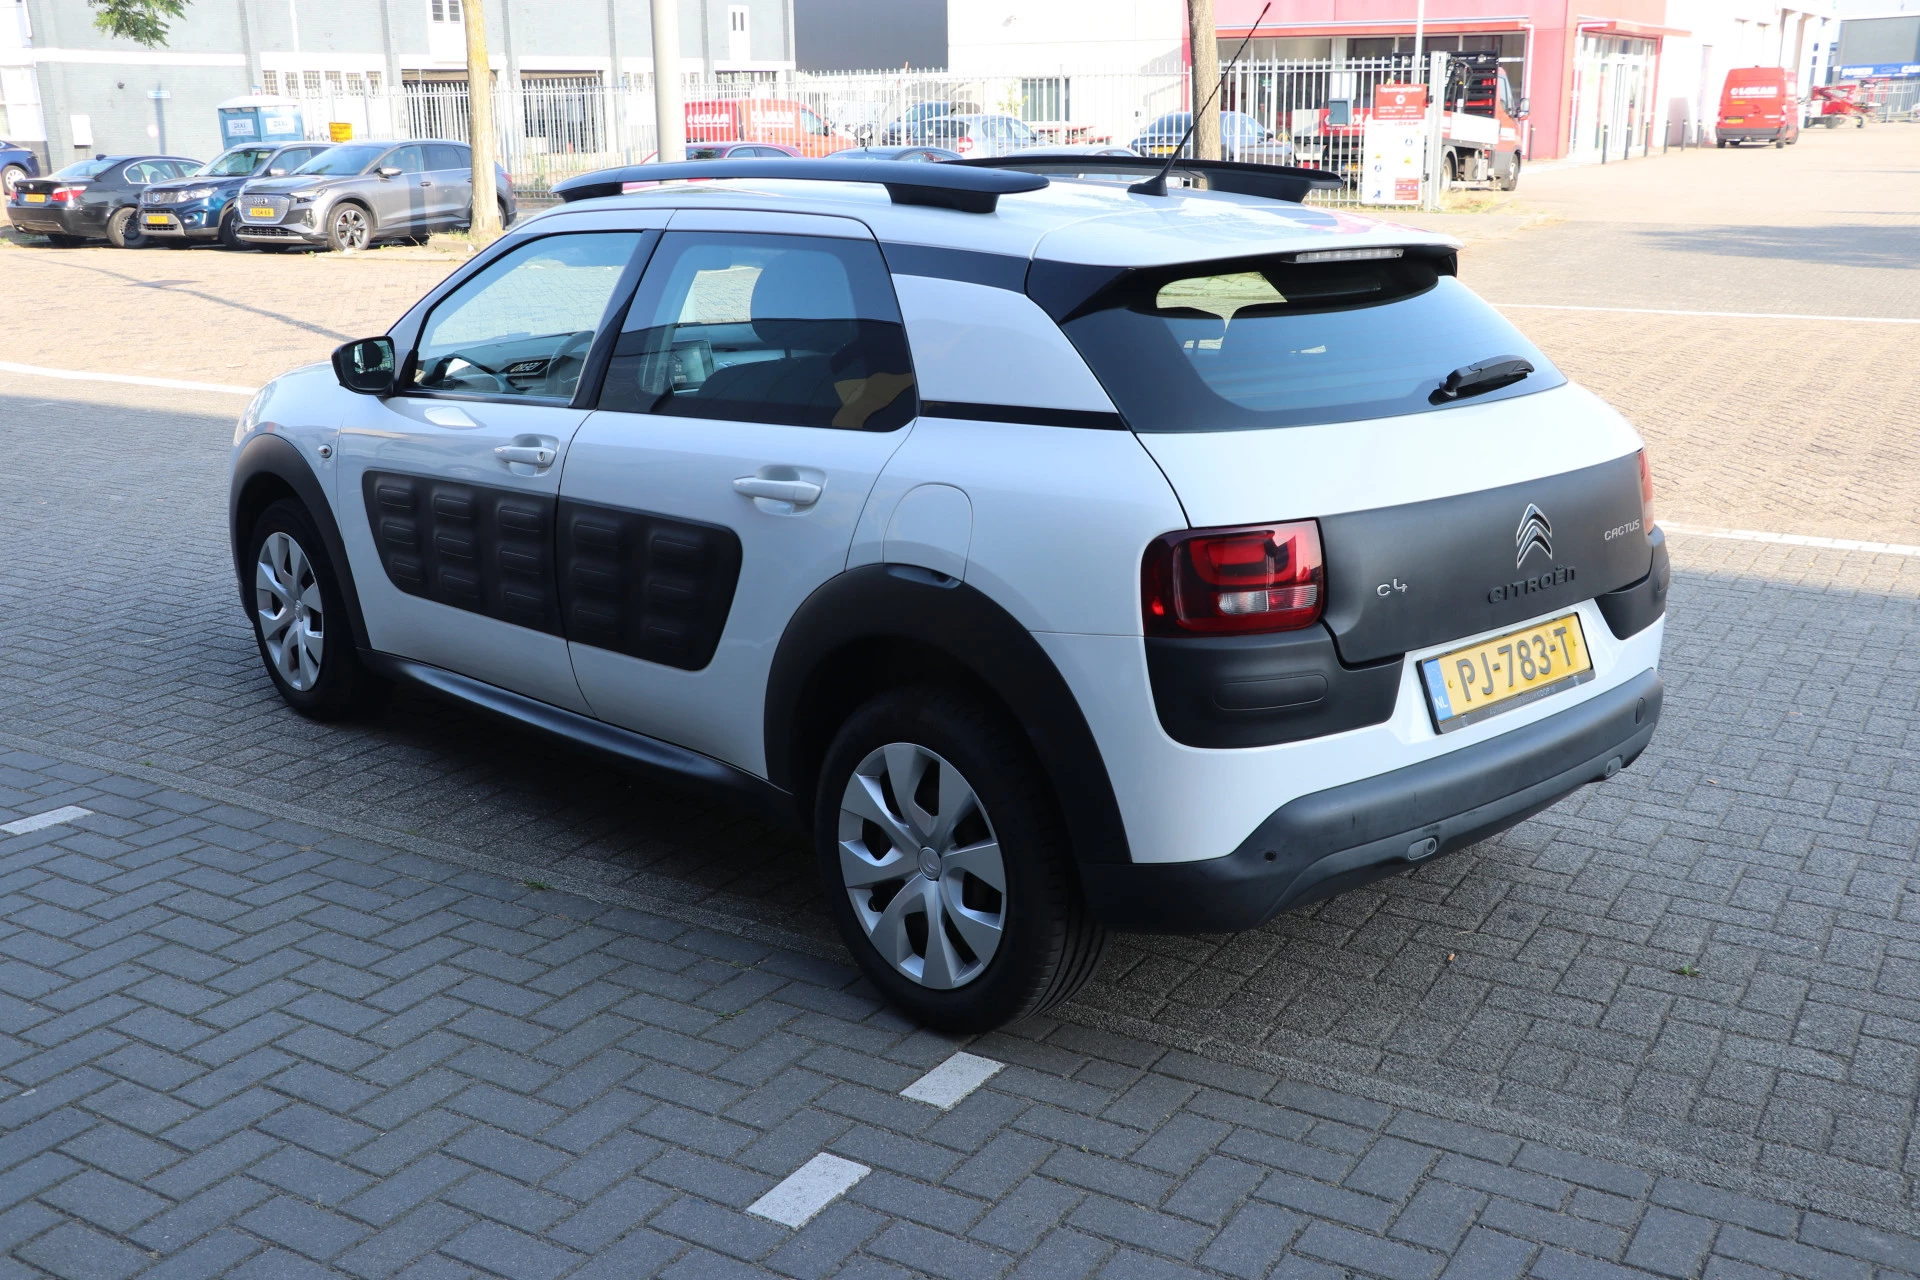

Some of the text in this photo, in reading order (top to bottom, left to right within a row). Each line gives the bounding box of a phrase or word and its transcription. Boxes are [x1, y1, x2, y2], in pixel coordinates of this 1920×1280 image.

[1603, 519, 1641, 542] CACTUS
[1376, 578, 1408, 597] C4
[1487, 564, 1577, 605] CITROËN
[1456, 626, 1572, 702] PJ-783-T
[1433, 695, 1449, 711] NL
